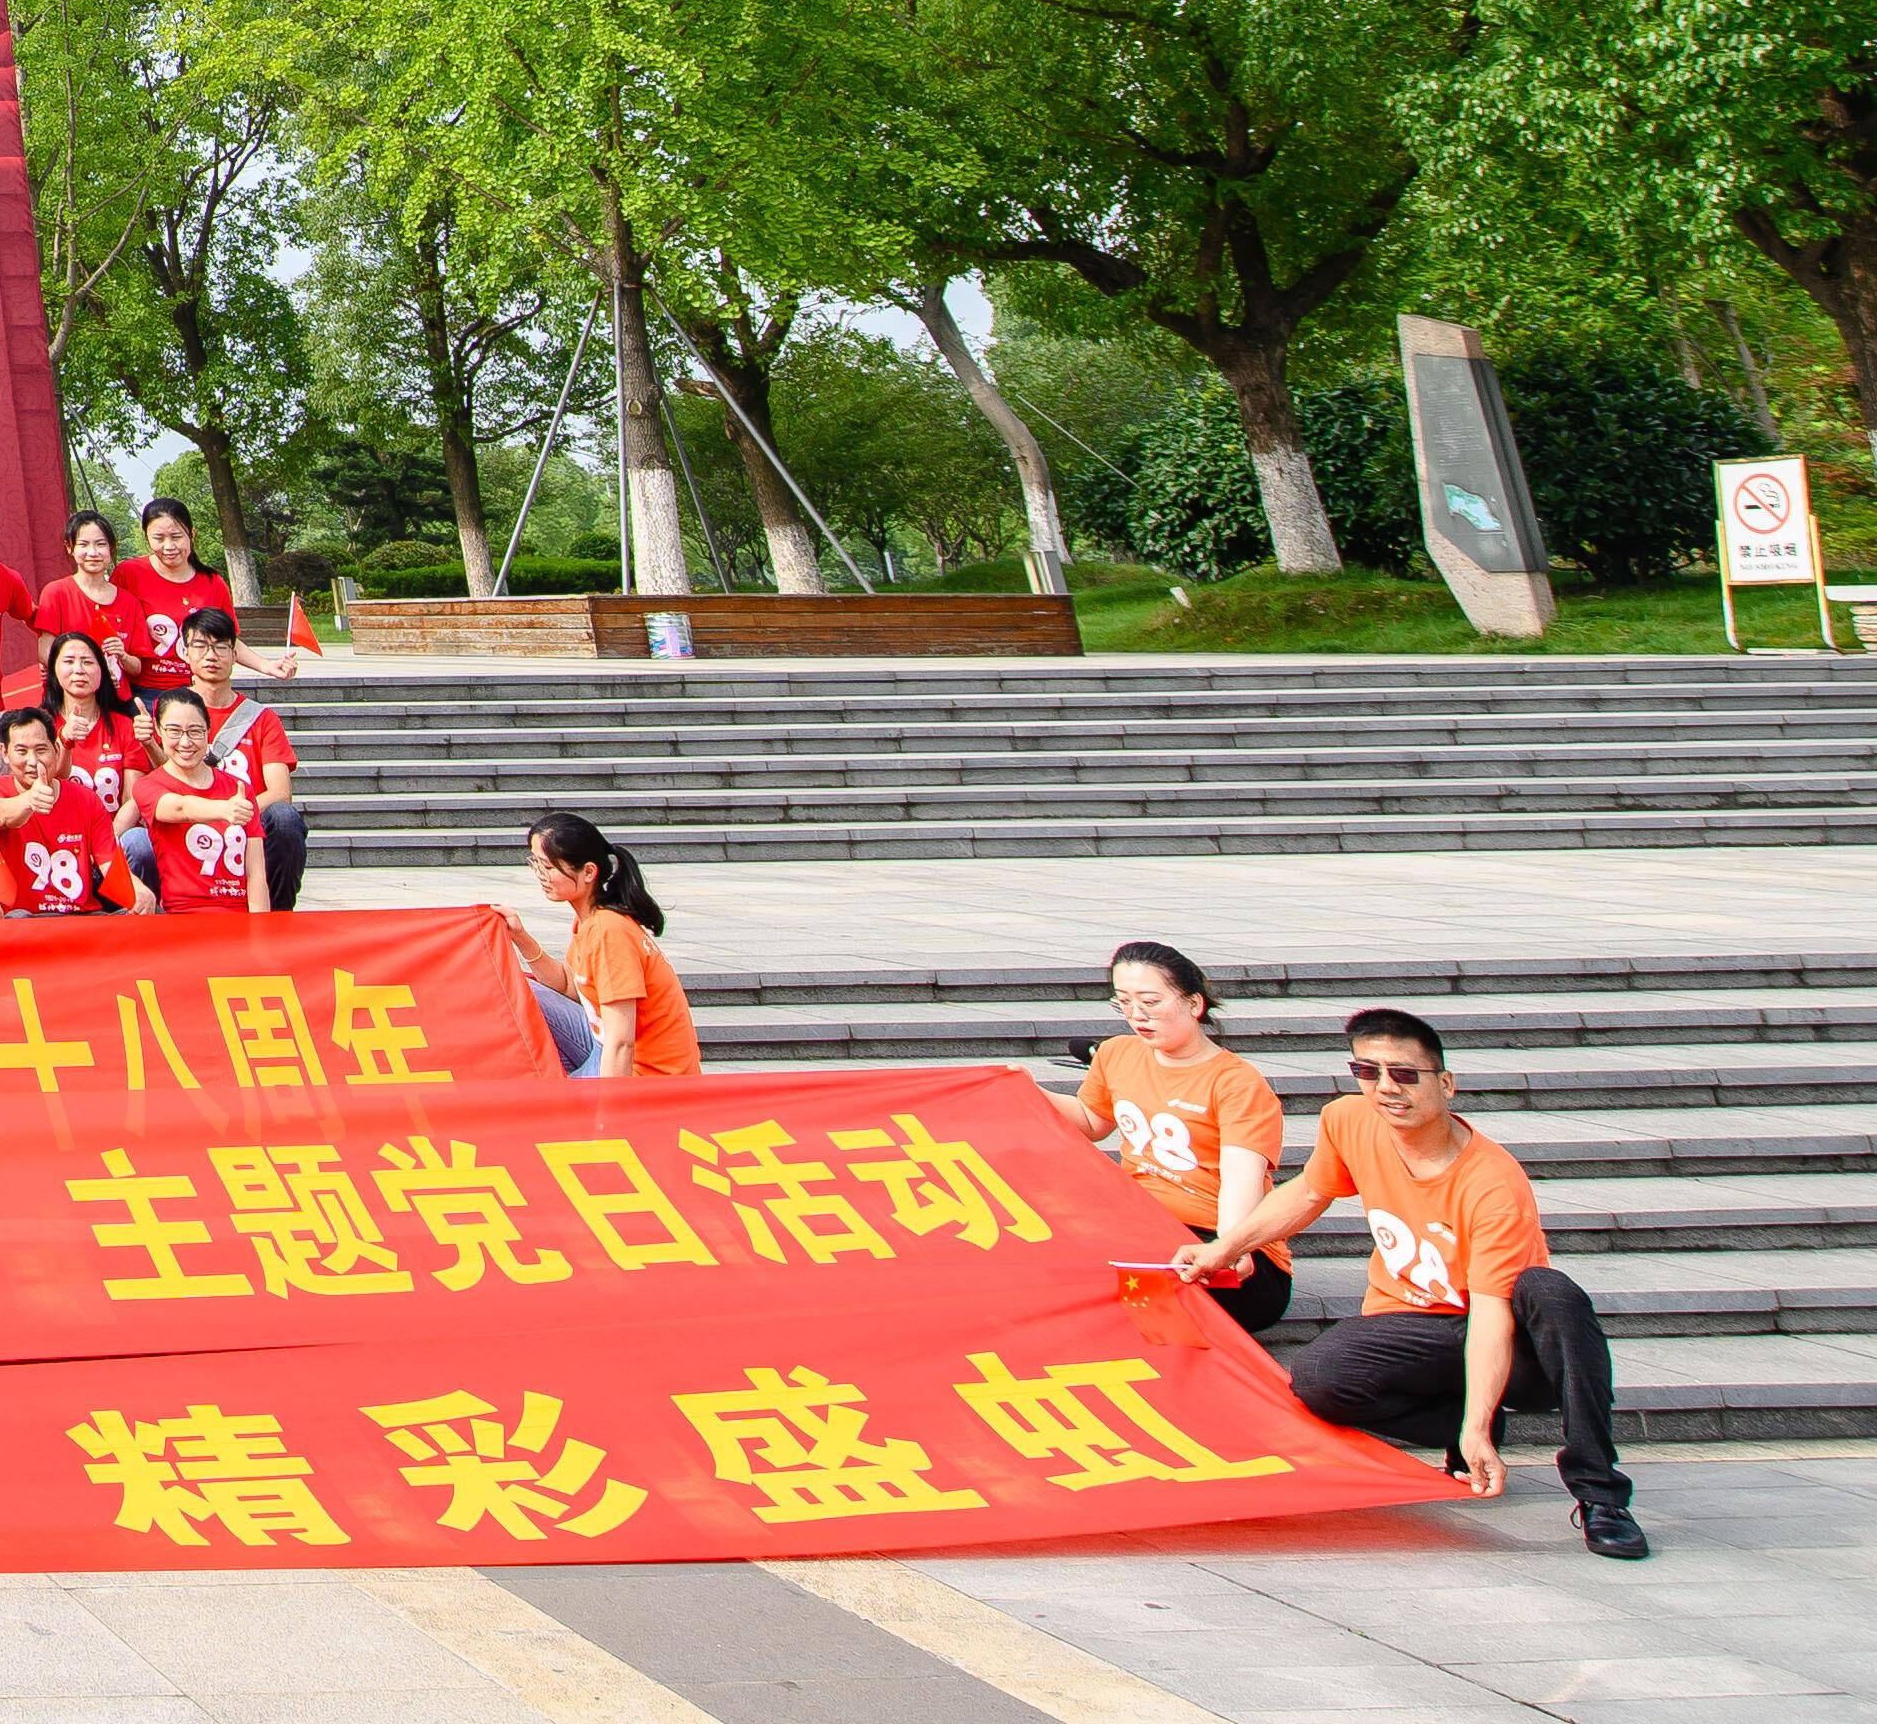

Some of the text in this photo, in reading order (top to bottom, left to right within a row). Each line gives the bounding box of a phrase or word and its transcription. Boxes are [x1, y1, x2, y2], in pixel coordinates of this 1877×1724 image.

[24, 842, 83, 899] 98
[185, 823, 246, 876] 98
[1114, 1099, 1198, 1171] 98
[66, 1112, 1053, 1301] 主题党日活动
[64, 1351, 1295, 1547] 精彩盛虹
